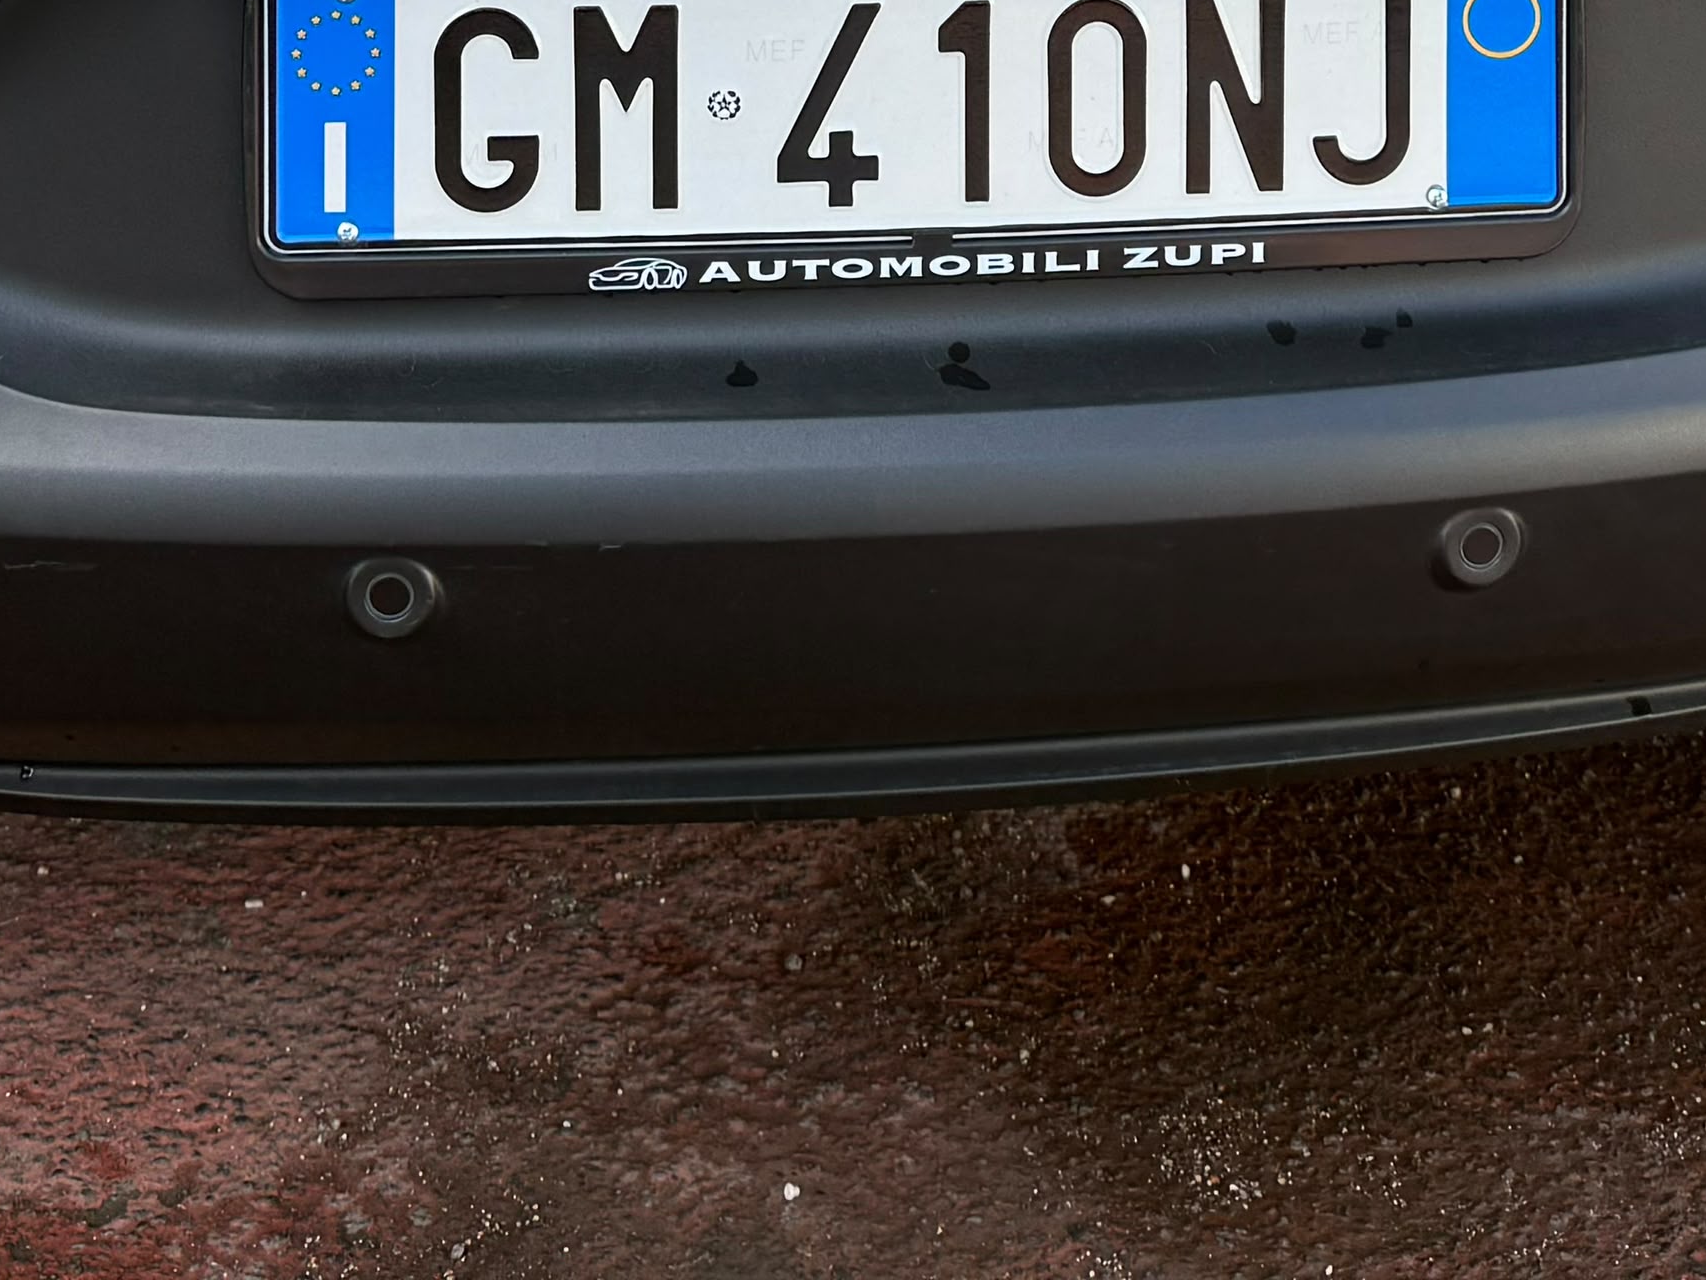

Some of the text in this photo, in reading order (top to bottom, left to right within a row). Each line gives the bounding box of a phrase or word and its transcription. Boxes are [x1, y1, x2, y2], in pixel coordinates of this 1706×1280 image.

[433, 4, 680, 214] GM
[323, 121, 347, 213] I
[698, 241, 1267, 284] AUTOMOBILI ZUPI
